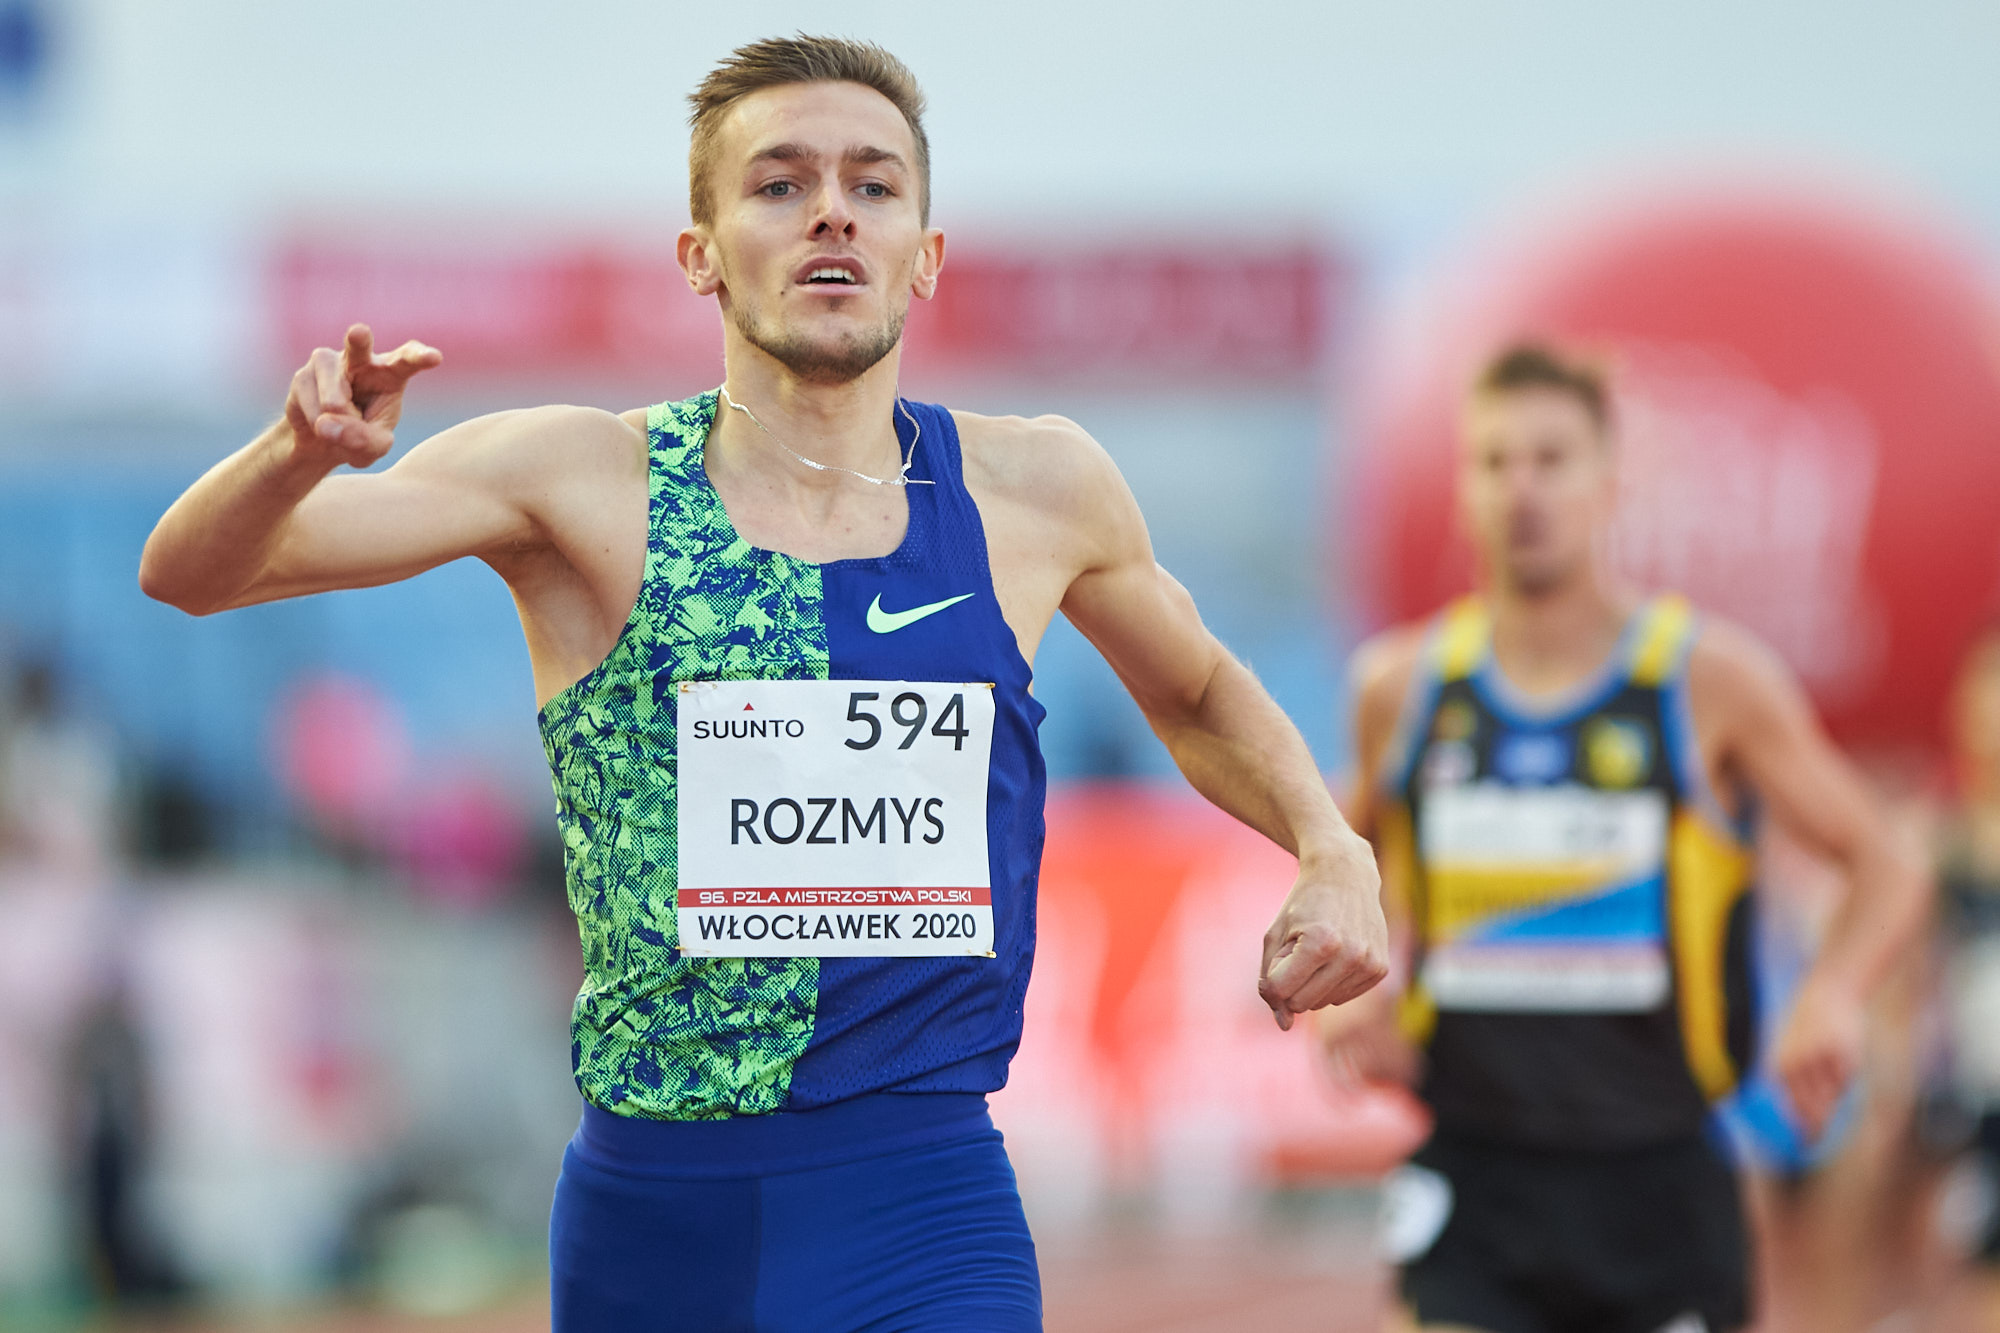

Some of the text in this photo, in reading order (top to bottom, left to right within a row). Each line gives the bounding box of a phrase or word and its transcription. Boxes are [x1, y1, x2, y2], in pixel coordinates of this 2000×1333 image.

[693, 719, 804, 739] SUUNTO
[844, 691, 970, 751] 594
[731, 797, 945, 845] ROZMYS
[699, 890, 972, 904] 96. PZLA MISTRZOSTWA POLSKI
[698, 913, 977, 940] WŁOCŁAWEK 2020
